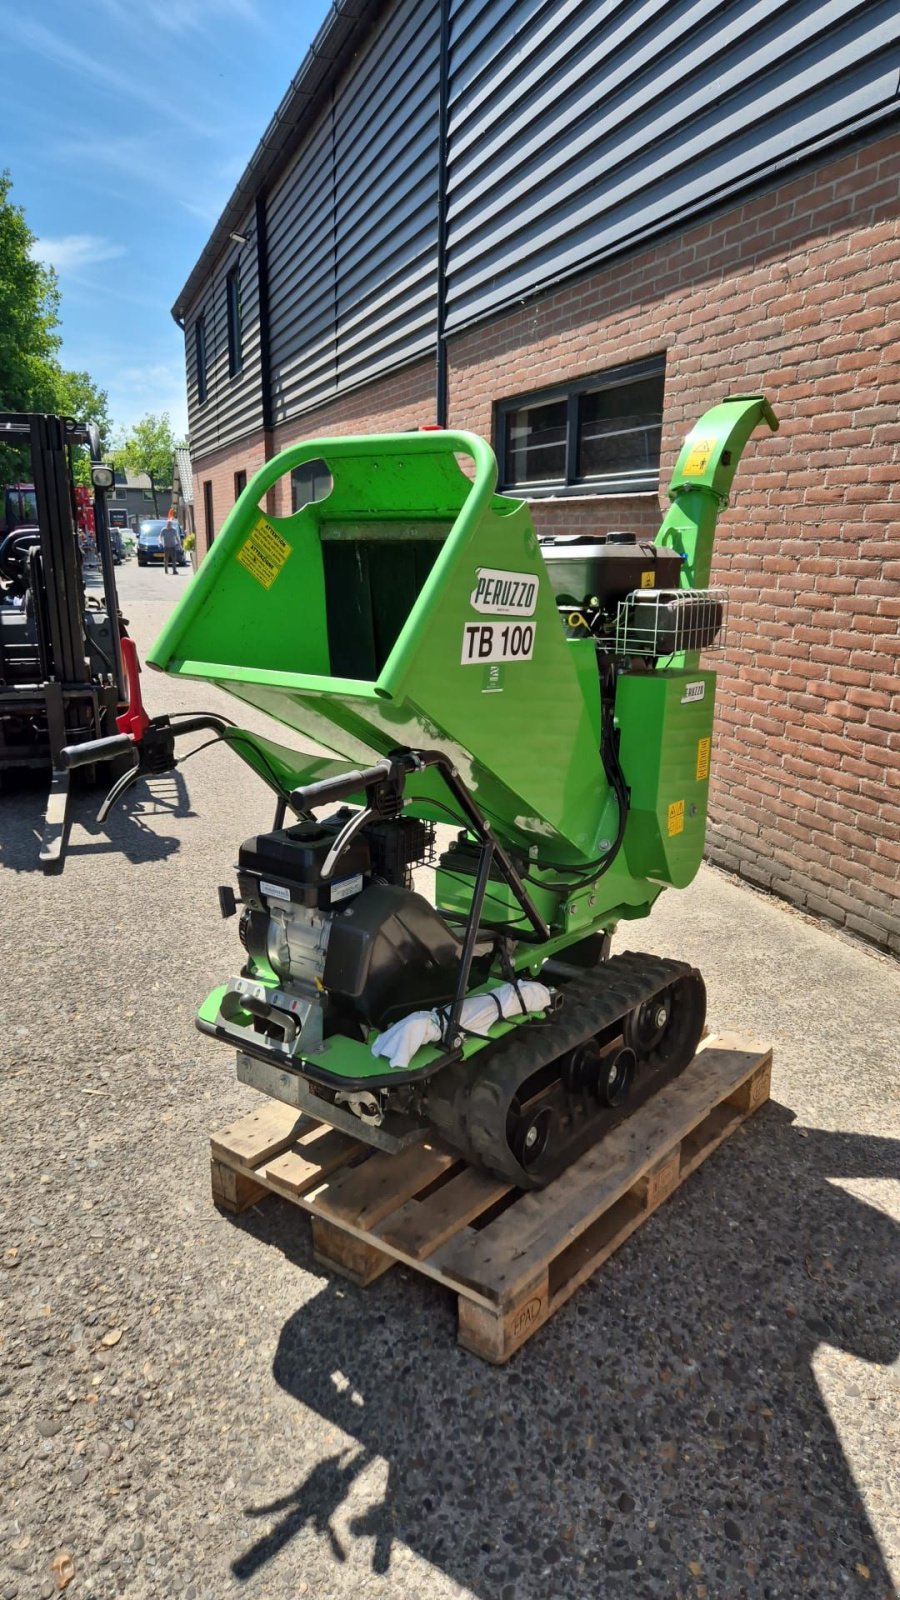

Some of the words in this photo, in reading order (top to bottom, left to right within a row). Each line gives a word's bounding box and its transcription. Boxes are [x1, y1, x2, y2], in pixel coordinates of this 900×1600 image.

[265, 525, 287, 548] ATTENTION
[474, 577, 536, 608] PERUZZO
[466, 626, 494, 658] TB
[501, 625, 534, 656] 100
